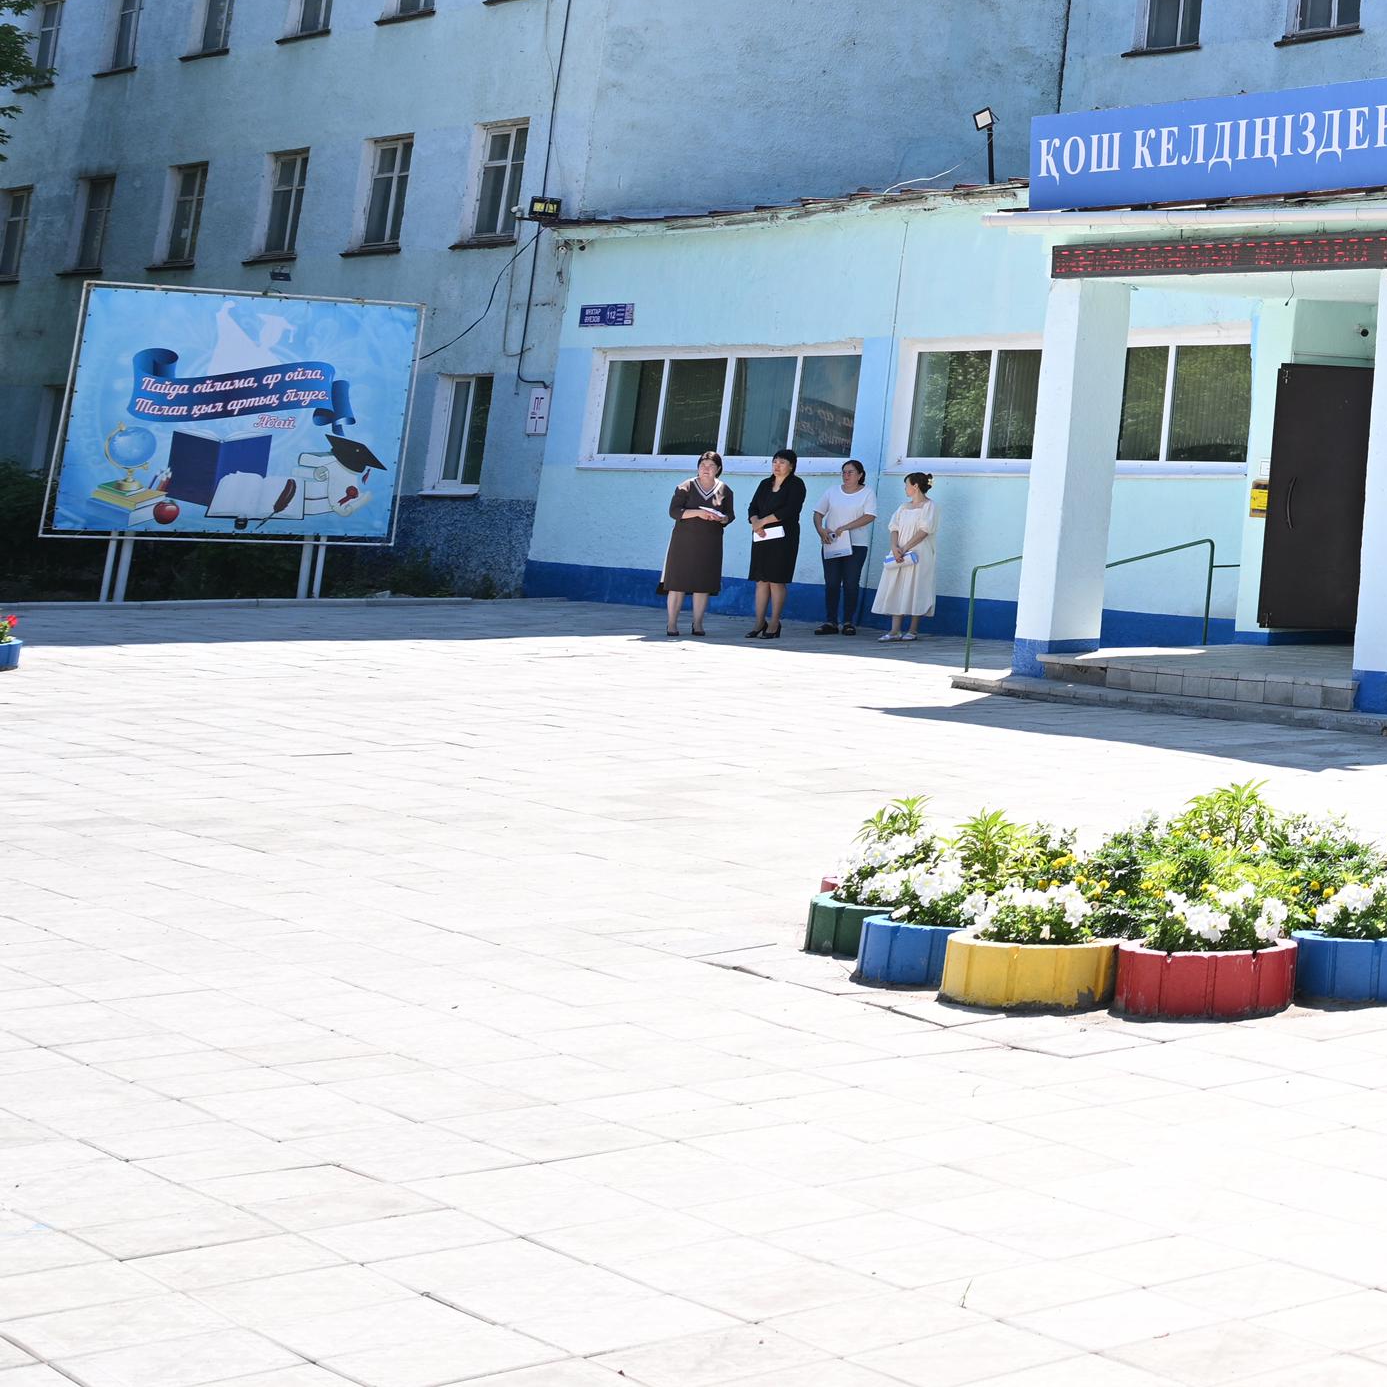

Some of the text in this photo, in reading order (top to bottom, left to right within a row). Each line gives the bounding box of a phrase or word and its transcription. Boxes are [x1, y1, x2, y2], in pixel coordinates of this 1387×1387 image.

[1037, 132, 1120, 185] ҚОШ
[140, 367, 325, 400] Пайда ойлама, ар ойла,
[135, 388, 330, 418] Талап қыл артық білуге.
[253, 414, 296, 429] Абай
